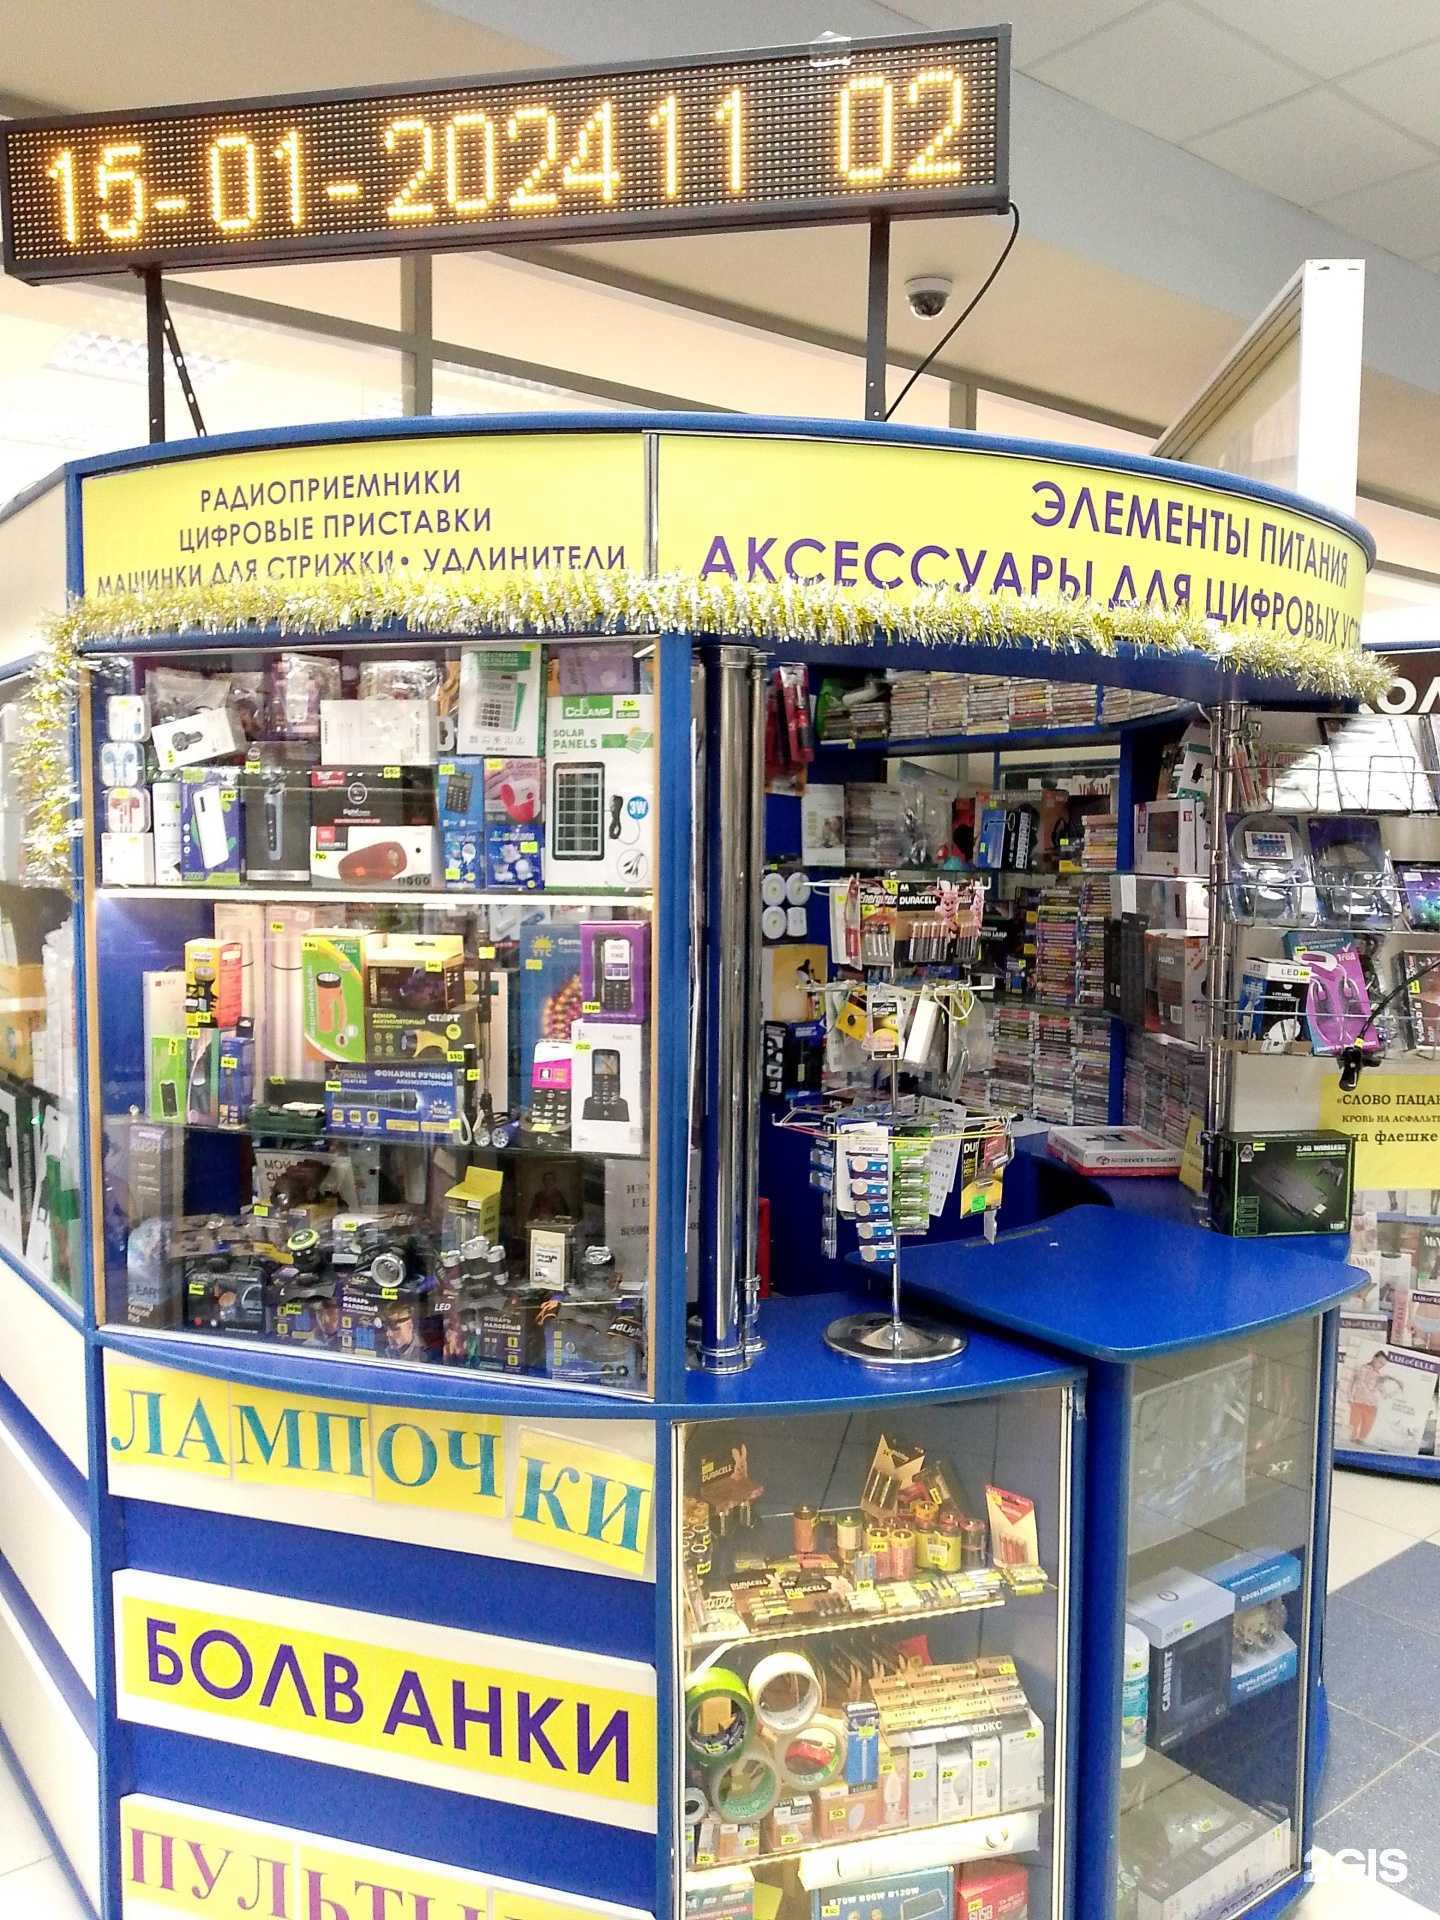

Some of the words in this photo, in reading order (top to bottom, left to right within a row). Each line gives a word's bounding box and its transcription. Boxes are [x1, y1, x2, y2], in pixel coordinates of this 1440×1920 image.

[839, 70, 963, 184] 02
[200, 468, 462, 513] РАДИОПРИЕМНИКИ
[178, 515, 315, 553] ЦИФРОВЫЕ
[322, 507, 492, 541] ПРИСТАВКИ
[1031, 480, 1250, 558] ЭЛЕМЕНТЫ
[1260, 522, 1348, 589] ПИТАНИЯ
[97, 563, 202, 598] МАШИНКИ
[210, 558, 257, 588] ДЛЯ
[267, 550, 394, 581] СТРИЖКИ
[423, 545, 626, 575] УДЛИНИТЕЛИ
[699, 534, 1093, 602] АКСЕССУАРЫ
[1107, 564, 1192, 612] ДЛЯ
[1205, 577, 1340, 647] ЦИФРОВЫХ
[553, 728, 585, 738] SOLAR
[553, 739, 598, 749] PANELS
[629, 801, 648, 815] 3W
[899, 895, 937, 905] DURACELL
[374, 1069, 417, 1079] ФОНАРИК
[418, 1071, 454, 1081] РУЧНОЙ
[1375, 1130, 1438, 1145] флешке
[434, 1302, 452, 1312] LED
[110, 1388, 651, 1554] ЛАМПОЧКИ
[730, 1578, 769, 1591] DURACELL
[145, 1616, 631, 1784] БОЛВАНКИ
